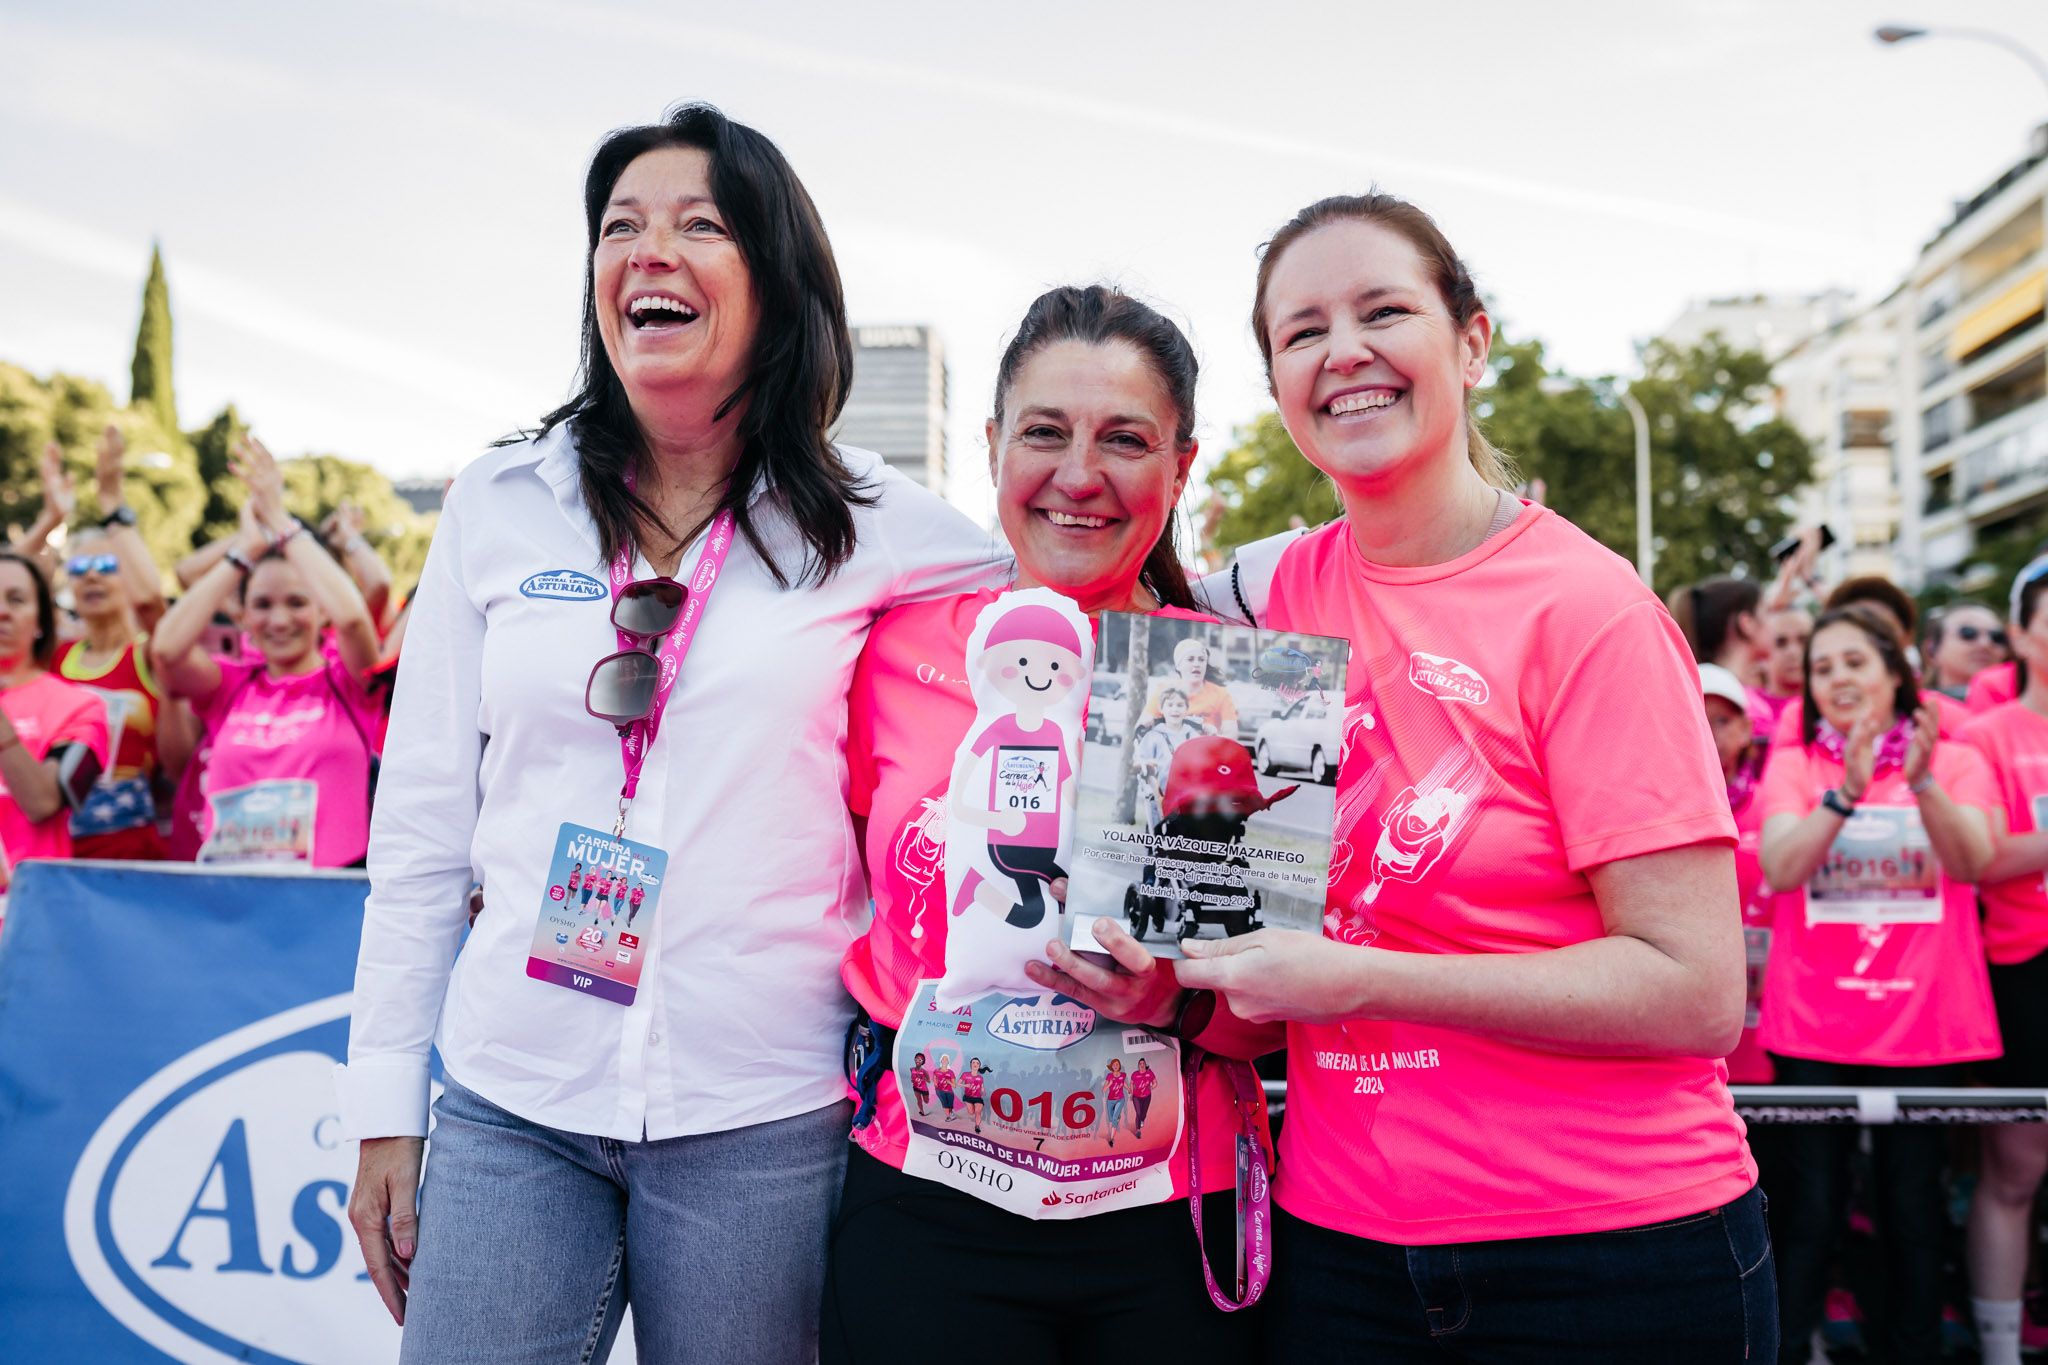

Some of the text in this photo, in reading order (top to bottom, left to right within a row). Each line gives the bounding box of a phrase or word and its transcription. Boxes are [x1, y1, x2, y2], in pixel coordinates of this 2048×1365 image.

[526, 579, 600, 596] ASTURIANA
[999, 770, 1028, 780] Carrera
[1015, 780, 1036, 793] Mujer
[1009, 795, 1040, 809] 016
[577, 833, 631, 857] CARRERA
[1102, 829, 1305, 864] YOLANDA VÁZQUEZ MAZARIEGO
[566, 840, 646, 878] MUJER
[1083, 848, 1318, 886] Por crear, hacer crecer y sentir la Carrera de la Mujer
[1847, 858, 1898, 879] 016
[1155, 867, 1184, 879] desde
[1185, 871, 1194, 881] el
[1196, 873, 1225, 885] primer
[1141, 885, 1255, 908] Madrid, 12 de mayo 2024
[549, 915, 576, 929] OYSHO
[581, 927, 602, 943] 20
[573, 974, 593, 988] VIP
[926, 1020, 953, 1029] MADRID
[1014, 1010, 1050, 1018] CENTRAL
[1314, 1050, 1357, 1071] ARRERA
[1371, 1052, 1390, 1071] LA
[1391, 1048, 1440, 1070] MUJER
[1353, 1076, 1384, 1094] 2024
[989, 1087, 1096, 1129] 016
[938, 1130, 1144, 1178] CARRERA DE LA MUJER MADRID
[1033, 1137, 1045, 1151] 7
[938, 1149, 1013, 1193] OYSHO
[1064, 1178, 1139, 1205] Santander
[1254, 1210, 1264, 1240] Carrera
[1252, 1251, 1266, 1275] Mujer
